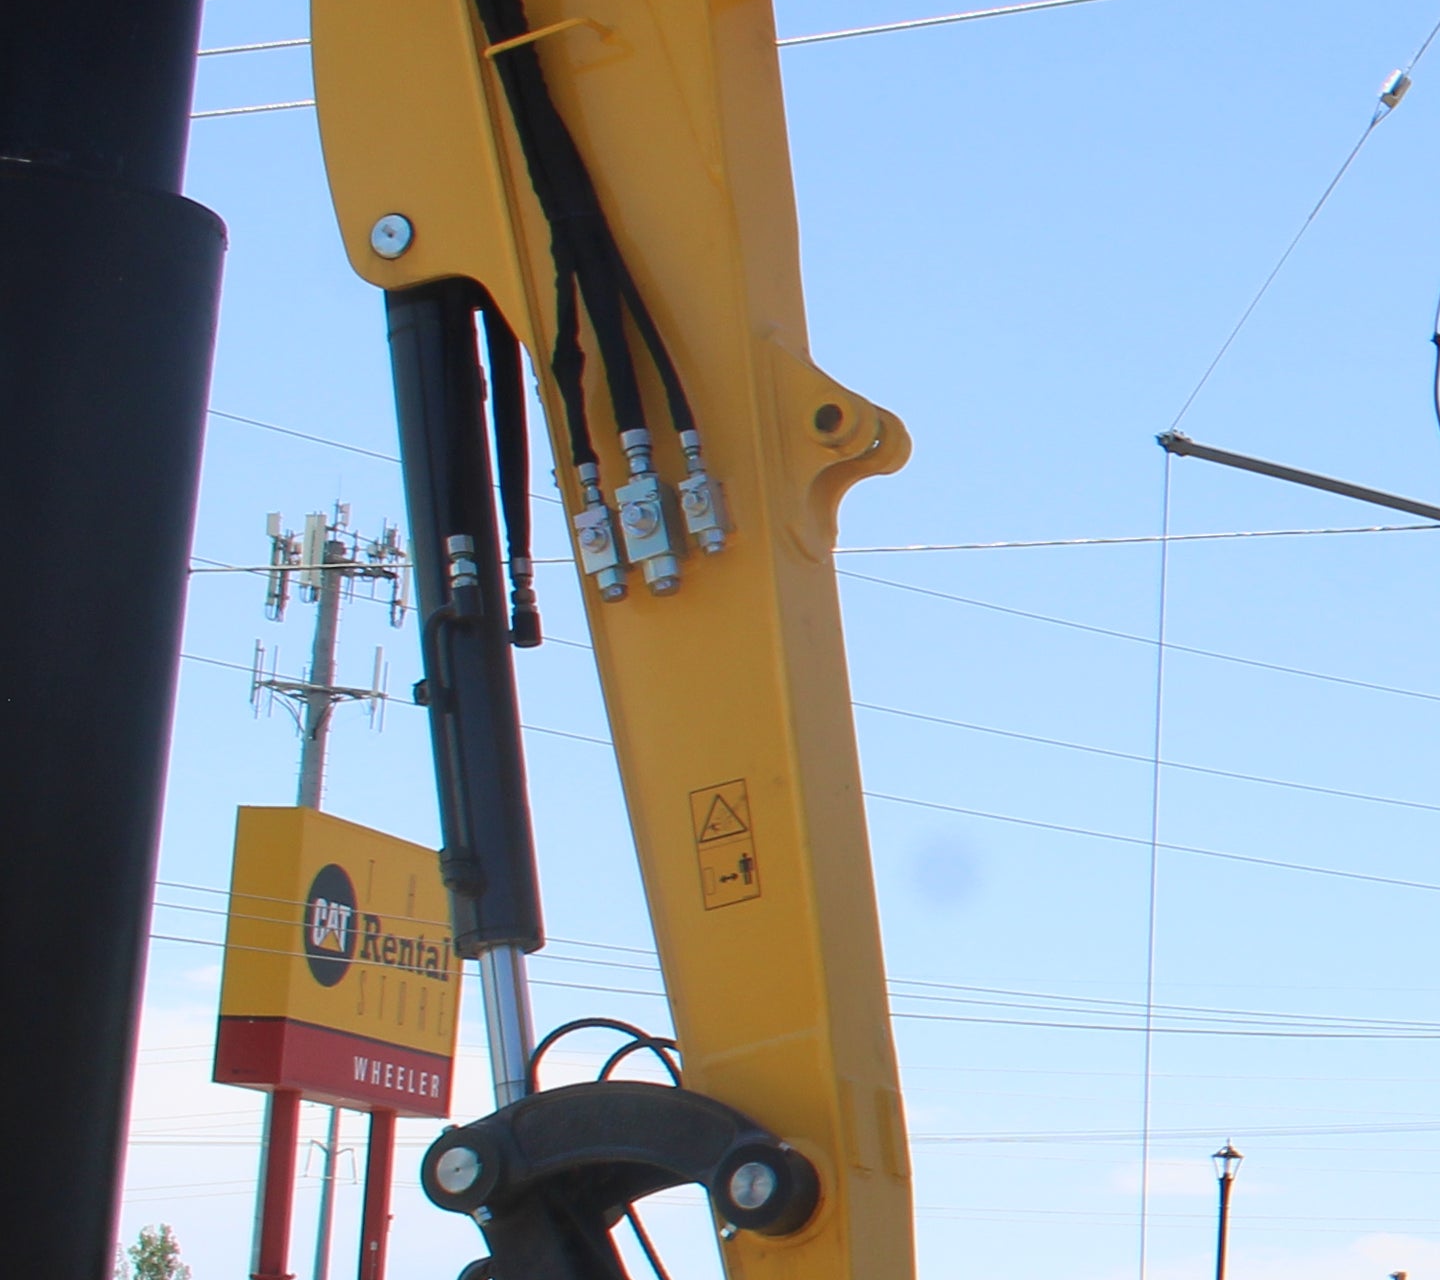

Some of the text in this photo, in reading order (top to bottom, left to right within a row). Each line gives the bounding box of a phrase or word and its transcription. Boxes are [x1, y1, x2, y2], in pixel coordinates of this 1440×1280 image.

[312, 897, 450, 983] CAT Rental
[357, 969, 448, 1037] STORE
[353, 1055, 441, 1099] WHEELER
